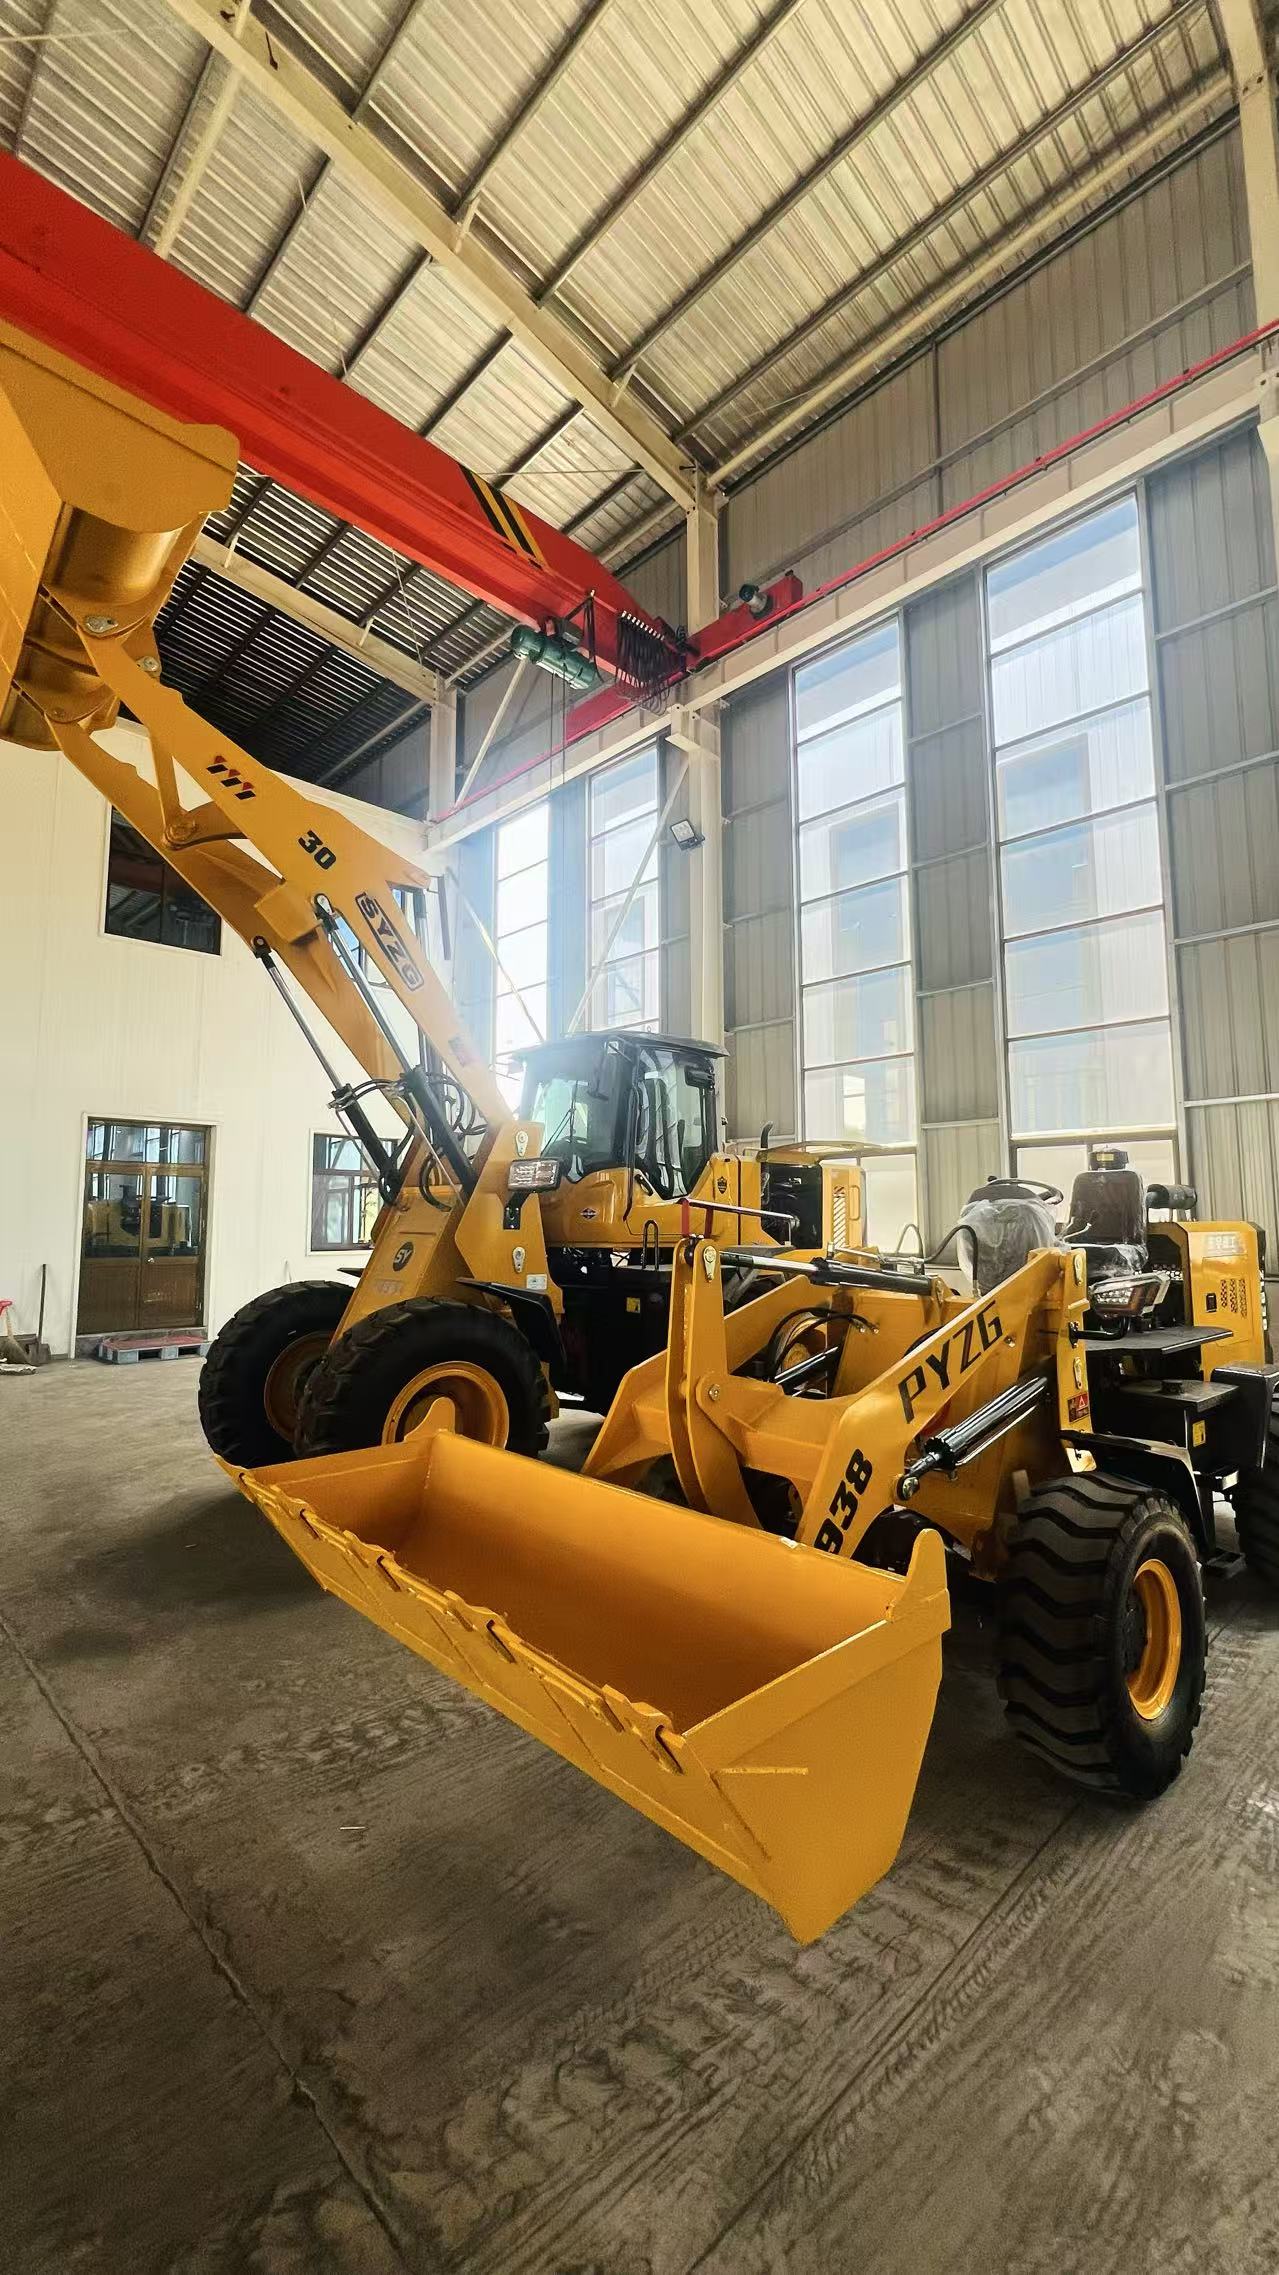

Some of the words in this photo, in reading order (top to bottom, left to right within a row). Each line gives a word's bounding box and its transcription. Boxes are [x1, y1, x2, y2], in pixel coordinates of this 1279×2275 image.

[298, 830, 337, 870] 30
[358, 895, 421, 987] SYZG
[394, 1248, 412, 1264] SY
[898, 1299, 1003, 1424] PYZG
[813, 1448, 873, 1556] 938
